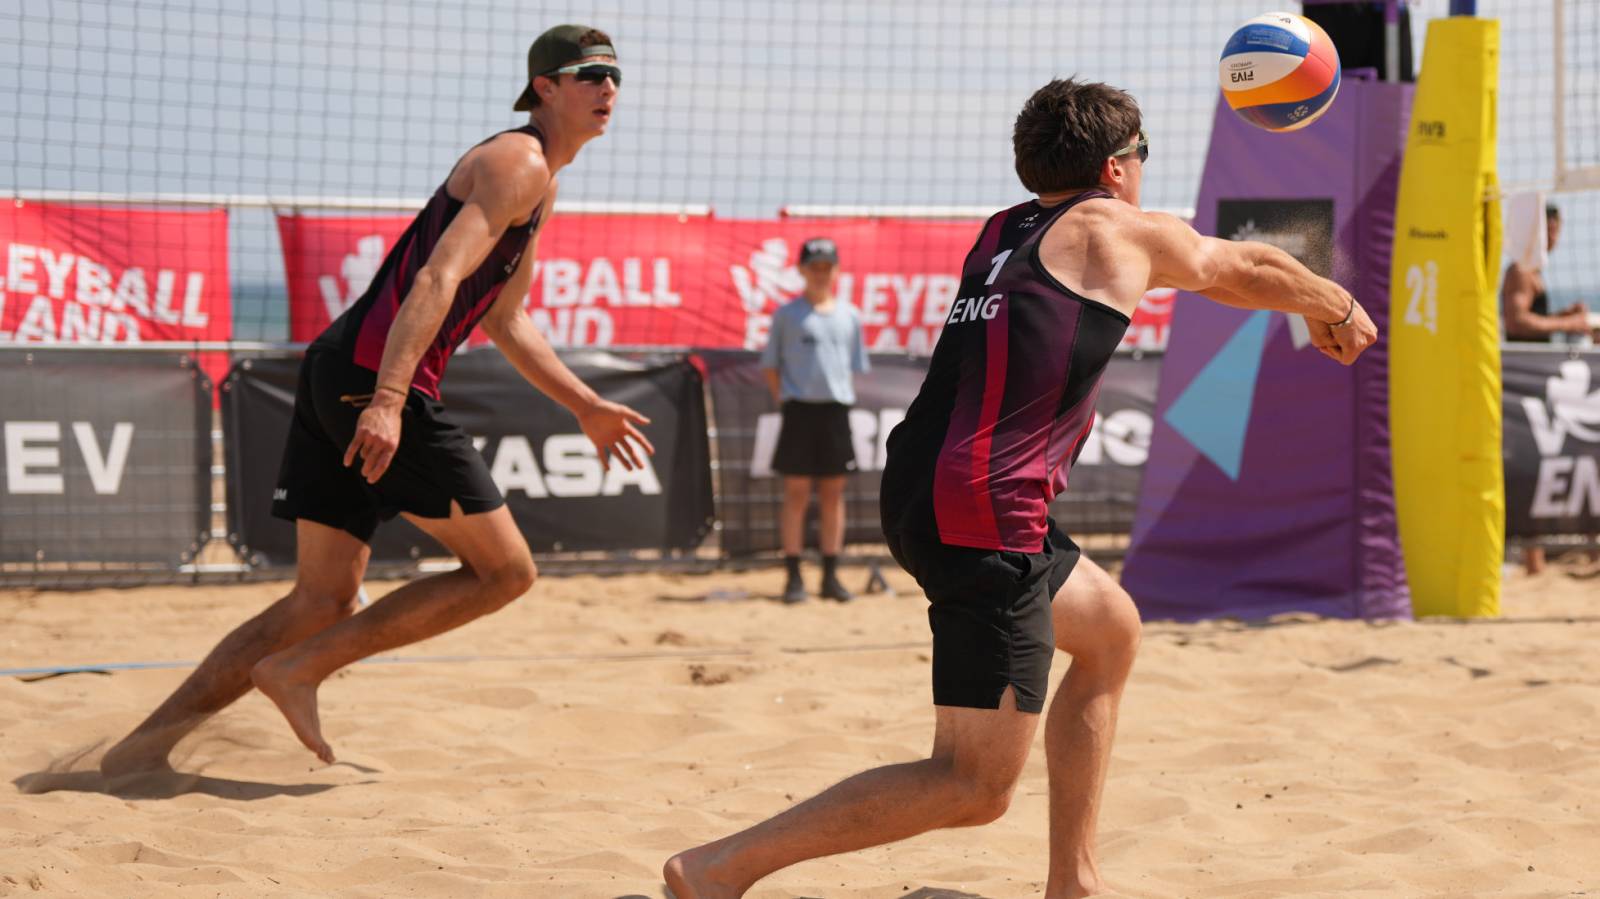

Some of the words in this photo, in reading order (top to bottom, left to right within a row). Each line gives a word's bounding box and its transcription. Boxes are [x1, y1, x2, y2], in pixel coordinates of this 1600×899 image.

[1230, 71, 1254, 83] FIVB
[0, 243, 209, 328] EYBALL
[984, 249, 1013, 286] 1
[947, 294, 1003, 325] ENG
[4, 421, 134, 495] EV
[472, 434, 662, 498] ASA
